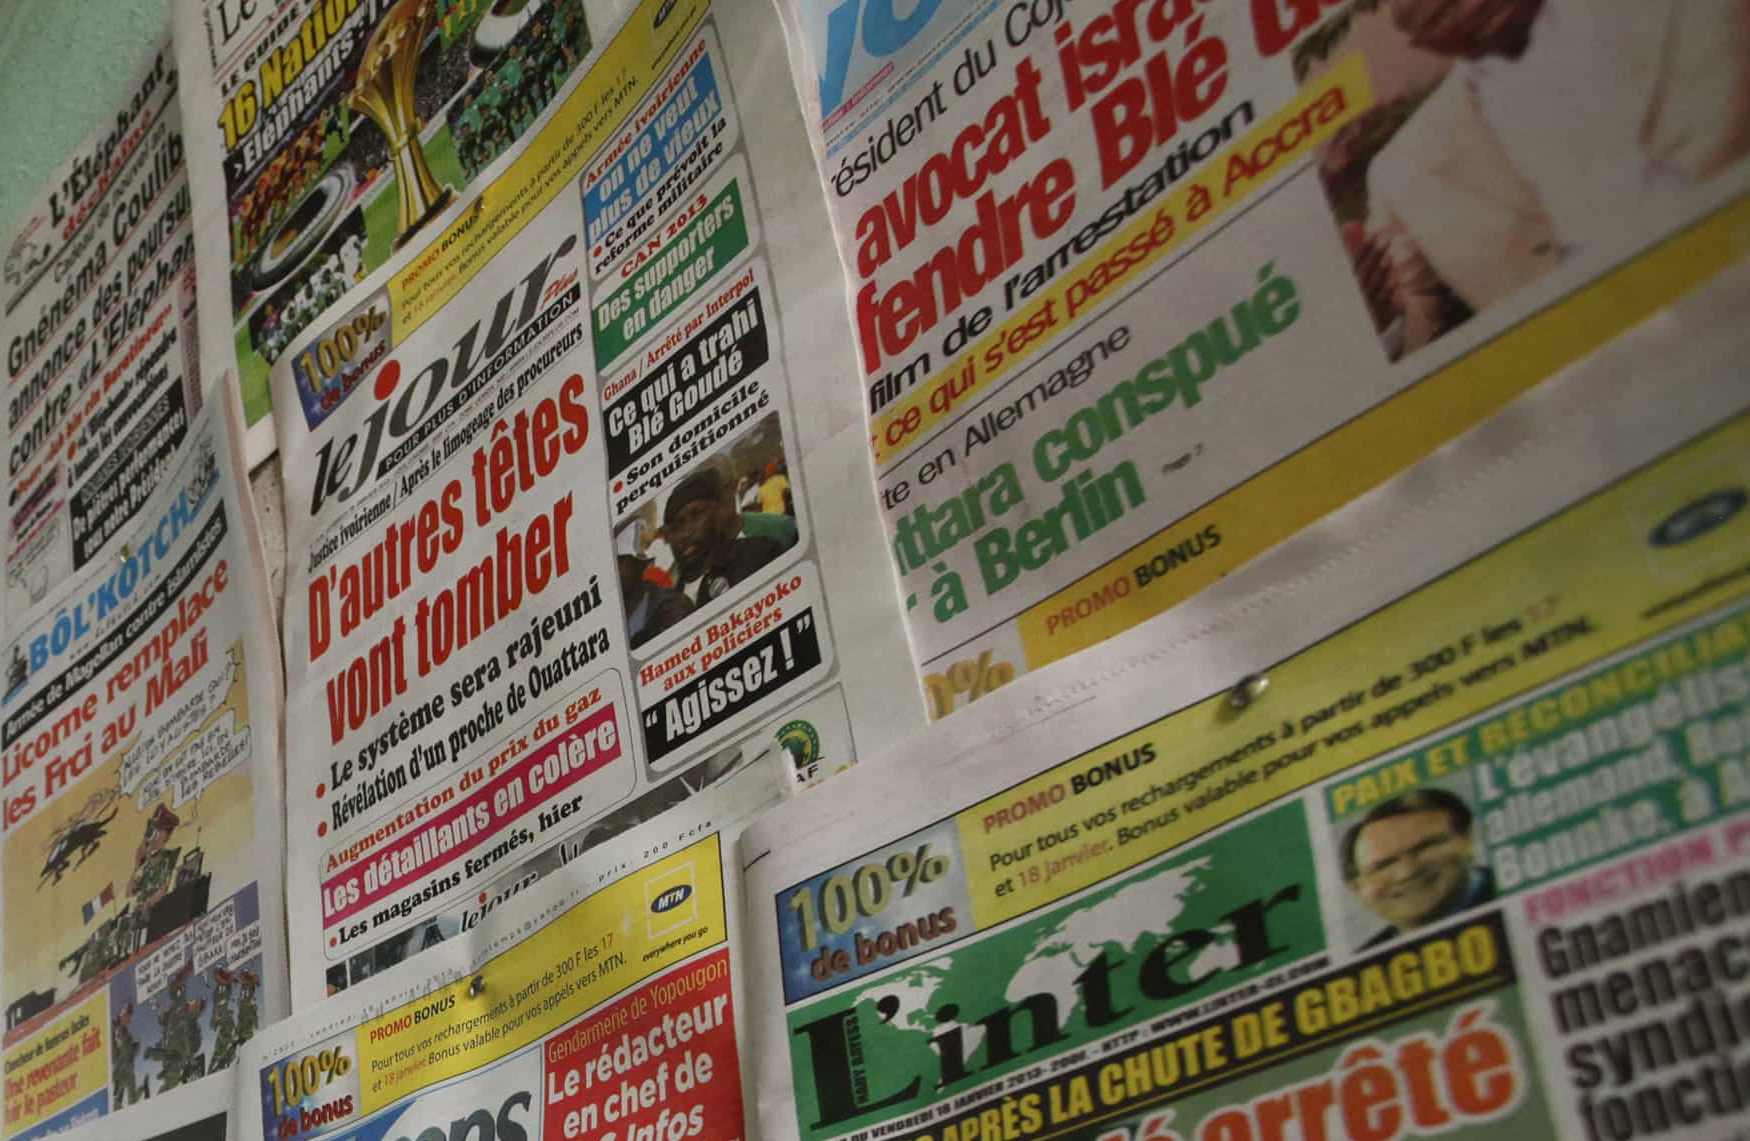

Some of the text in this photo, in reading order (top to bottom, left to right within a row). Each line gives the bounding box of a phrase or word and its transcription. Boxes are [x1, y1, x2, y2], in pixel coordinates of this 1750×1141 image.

[1090, 12, 1229, 191] Blé
[626, 197, 655, 232] que
[855, 56, 1051, 279] avocat
[1065, 87, 1346, 318] passé Accra
[620, 234, 663, 278] CAN
[634, 193, 735, 303] supporters
[942, 306, 992, 358] de
[1003, 100, 1255, 312] l'arrestation
[705, 267, 755, 318] Interpol
[9, 318, 86, 430] annonce
[300, 306, 388, 393] 100%
[423, 405, 454, 442] PLUS
[455, 291, 576, 418] D'INFORMATION
[517, 322, 584, 403] procureurs
[608, 297, 759, 440] Ce qui a trahi
[628, 343, 744, 457] Blé Goudé
[964, 325, 1132, 458] Allemagne
[1033, 261, 1302, 483] conspué
[9, 382, 72, 476] contre
[615, 390, 771, 516] perquisitionné
[626, 379, 761, 486] Son domicile
[307, 480, 465, 663] D'autres
[472, 373, 590, 525] têtes
[973, 459, 1147, 598] Berlin
[1135, 524, 1222, 588] BONUS
[106, 560, 228, 703] remplace
[326, 490, 574, 746] vont tomber
[529, 628, 611, 699] Ouattara
[639, 640, 703, 686] Hamed
[663, 607, 783, 693] aux policiers
[2, 784, 36, 832] les
[101, 704, 136, 755] au
[145, 626, 209, 716] Mali
[330, 575, 603, 792] Le système sera rajeuni
[364, 720, 618, 897] détaillants en colère
[488, 737, 529, 781] prix
[982, 743, 1157, 836] PROMO BONUS
[989, 730, 1277, 872] Pour tous rechargements
[338, 792, 584, 946] Les magasins fermés, hier
[789, 842, 948, 953] 100%
[369, 1014, 412, 1045] PROMO
[462, 951, 627, 1054] valable MTN.
[649, 959, 730, 1011] Yopougon
[794, 884, 1302, 1132] L'inter
[266, 1045, 351, 1117] 100%
[371, 1054, 393, 1074] Pour
[547, 993, 729, 1105] Le rédacteur
[563, 1050, 714, 1138] en chef de
[1098, 1026, 1227, 1109] CHUTE
[1231, 1002, 1289, 1057] DE
